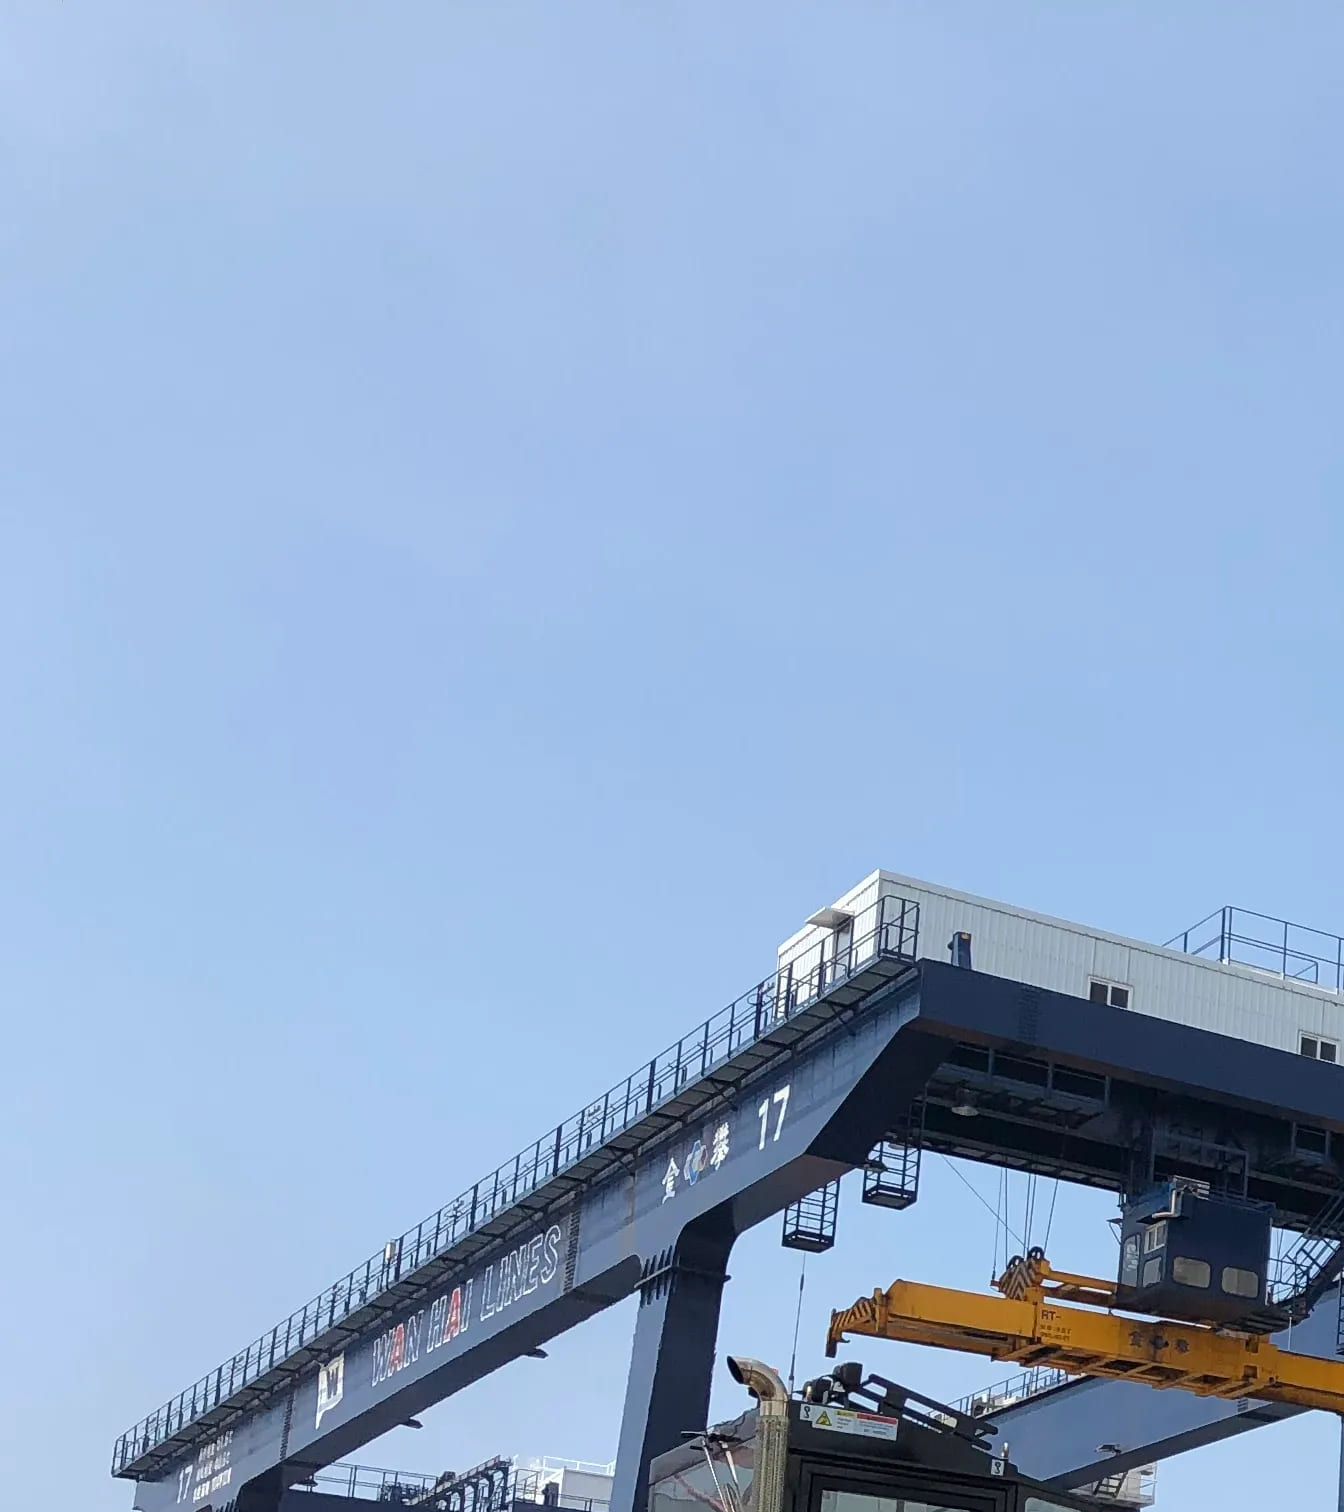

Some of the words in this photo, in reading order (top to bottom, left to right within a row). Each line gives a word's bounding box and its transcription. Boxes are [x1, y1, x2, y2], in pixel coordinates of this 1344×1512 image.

[758, 1084, 791, 1151] 17
[371, 1309, 425, 1388] WAN
[426, 1278, 474, 1353] HAI
[480, 1224, 562, 1322] LINES
[176, 1463, 194, 1505] 17
